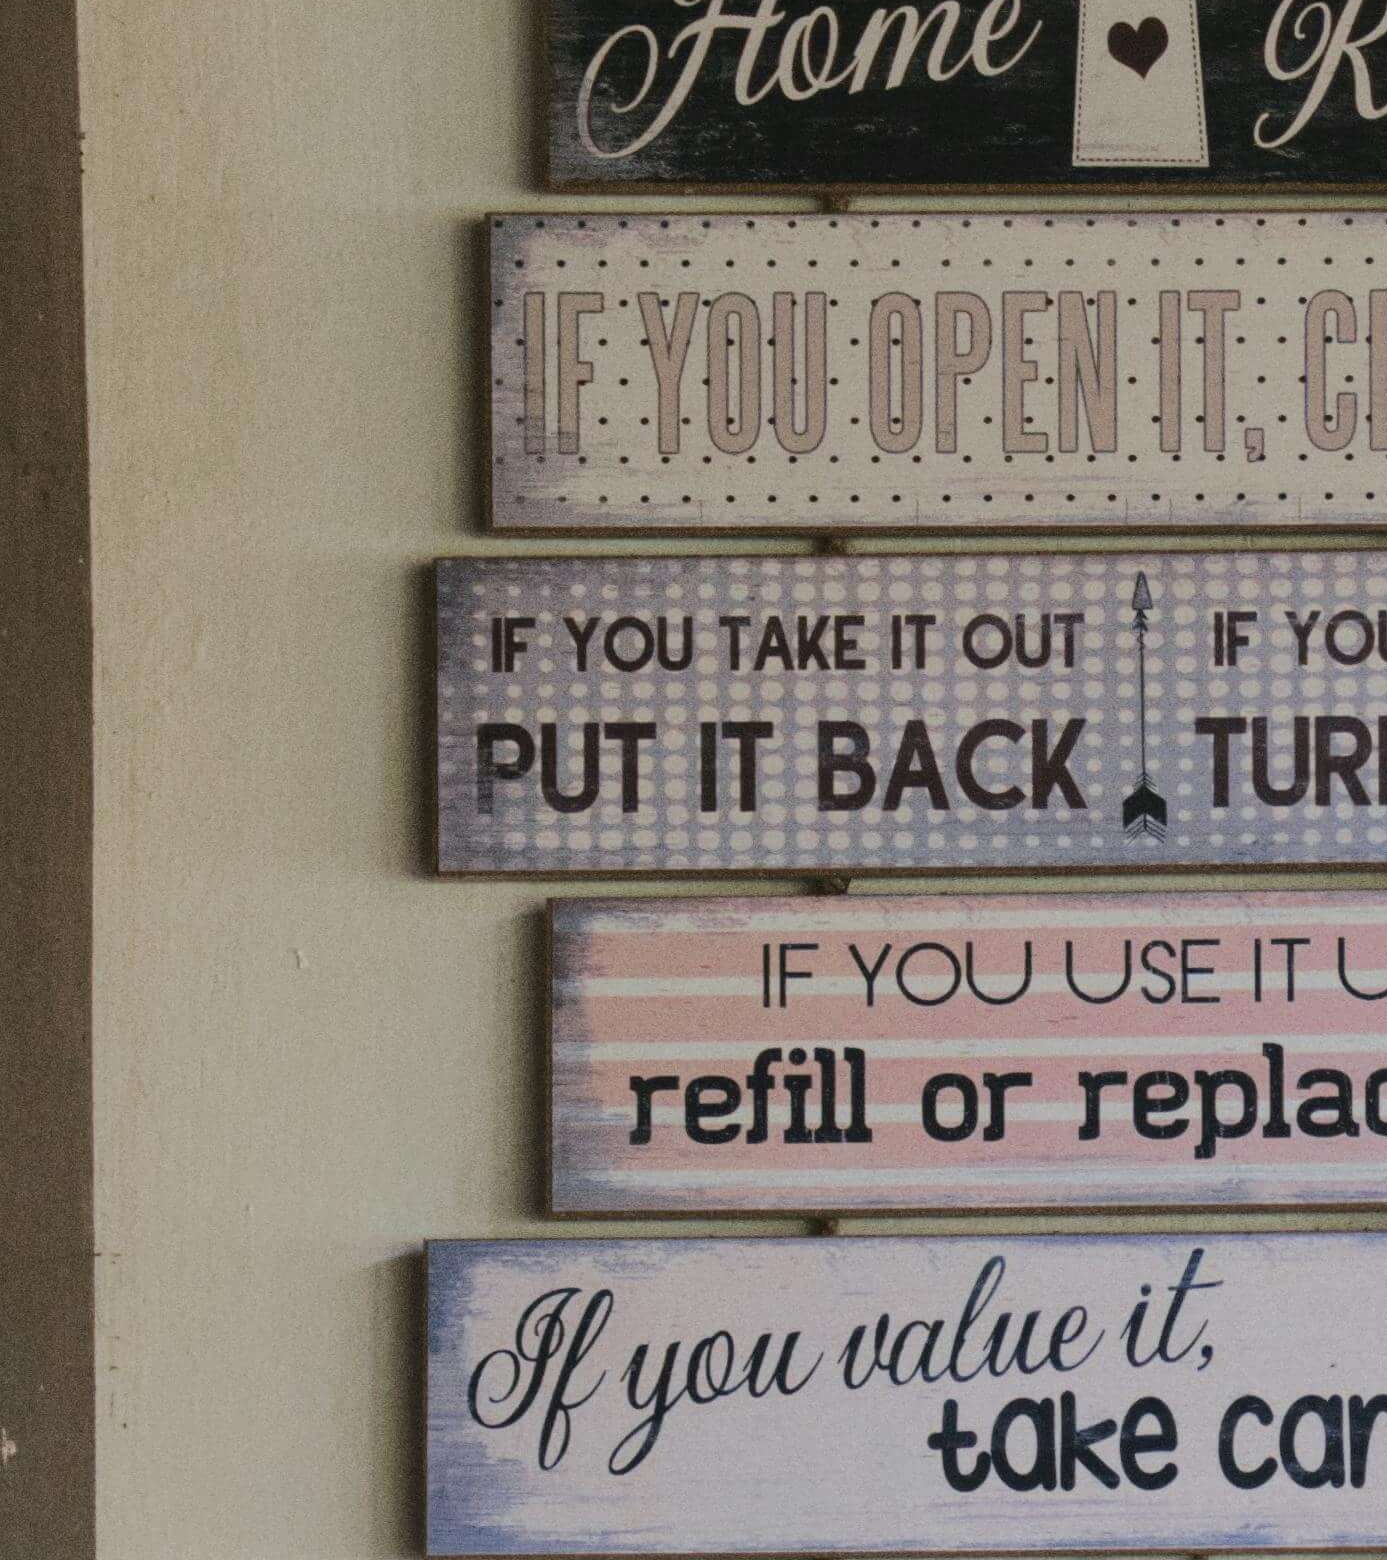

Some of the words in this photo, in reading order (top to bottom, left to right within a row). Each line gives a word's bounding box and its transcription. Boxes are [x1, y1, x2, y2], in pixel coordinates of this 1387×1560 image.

[522, 290, 605, 458] IF
[636, 290, 829, 456] YOU
[868, 288, 1117, 456] OPEN
[1158, 288, 1267, 462] IT,
[490, 616, 556, 674] IF
[570, 613, 695, 674] YOU
[719, 613, 876, 673] TAKE
[890, 613, 941, 671] IT
[963, 610, 1086, 671] OUT
[1212, 609, 1272, 667] IF
[473, 718, 657, 815] PUT
[699, 717, 775, 813] IT
[816, 714, 1089, 813] BACK
[761, 942, 820, 1009] IF
[849, 941, 1034, 1009] YOU
[1063, 938, 1220, 1006] USE
[1252, 937, 1311, 1004] IT
[626, 1045, 873, 1148] refill
[919, 1063, 1033, 1145] or
[466, 1287, 613, 1473] If
[609, 1346, 824, 1478] you
[838, 1255, 1111, 1384] value
[1117, 1248, 1225, 1373] it,
[926, 1390, 1179, 1494] take
